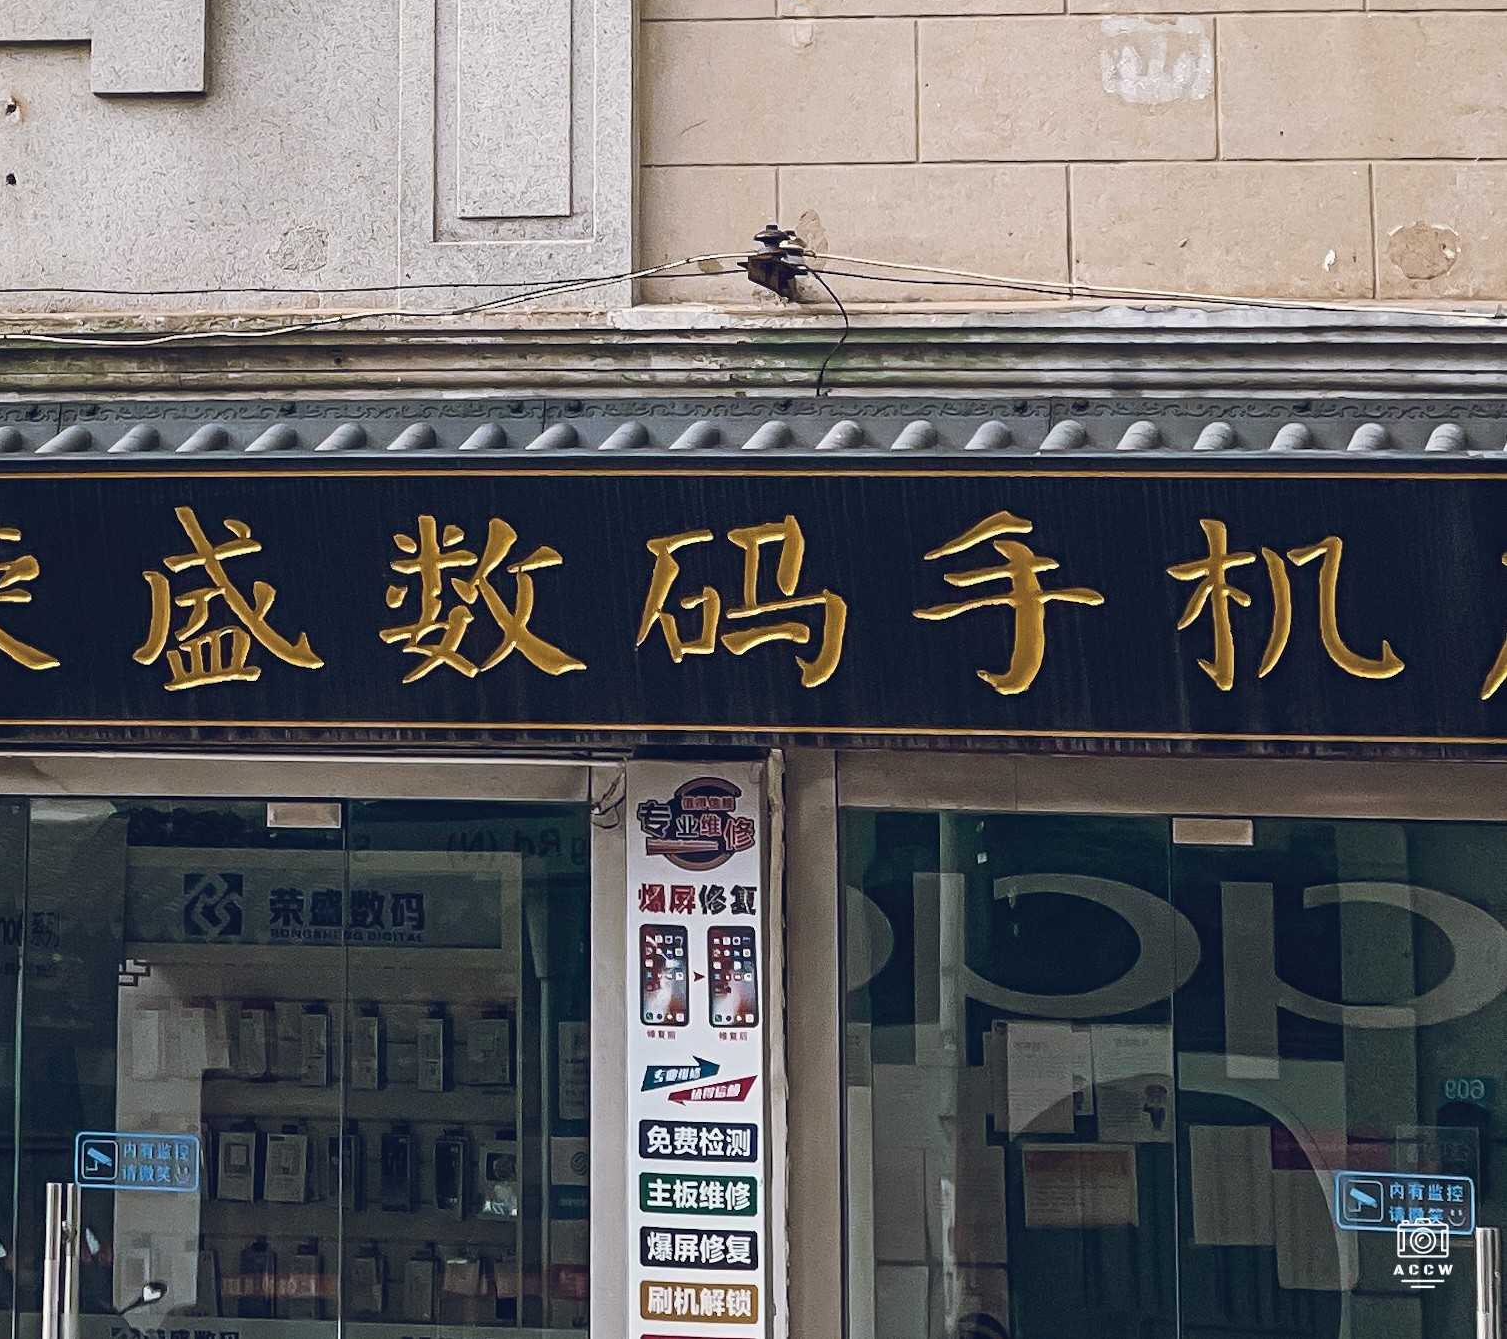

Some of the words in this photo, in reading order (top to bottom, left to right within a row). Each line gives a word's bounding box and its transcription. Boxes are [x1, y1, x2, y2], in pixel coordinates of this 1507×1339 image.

[637, 800, 756, 851] 专业维修
[269, 888, 425, 931] 荣盛数码
[638, 883, 758, 916] 爆屏修复
[846, 871, 1507, 1079] pp
[646, 1125, 751, 1157] 免费检测
[646, 1178, 751, 1210] 主板维修
[1389, 1182, 1464, 1203] 内有监控
[647, 1231, 752, 1264] 爆屏修复
[647, 1286, 752, 1317] 刷机解锁
